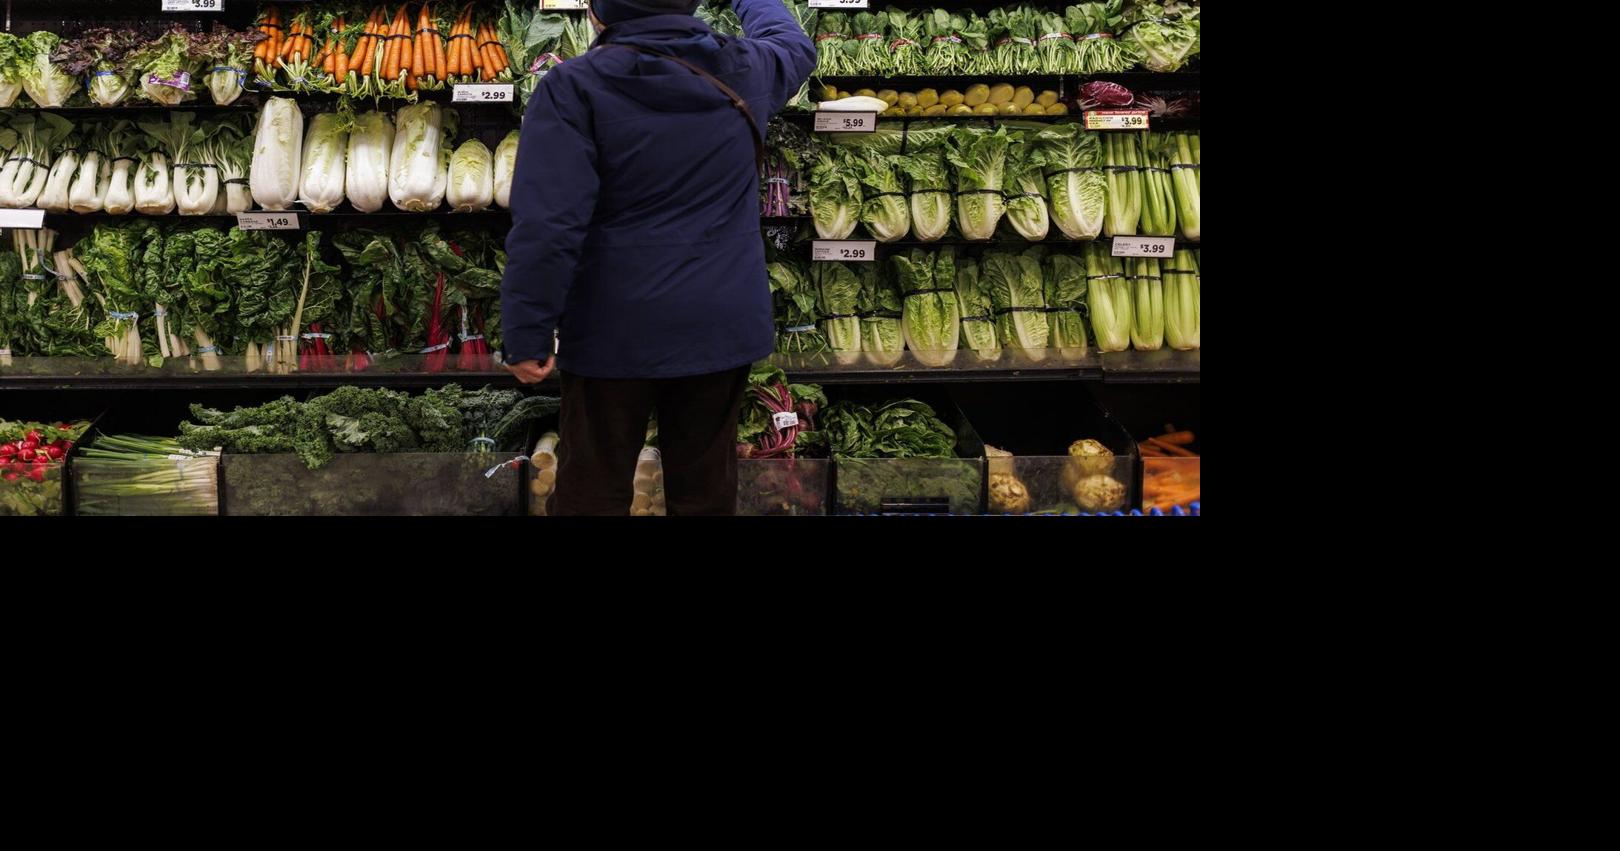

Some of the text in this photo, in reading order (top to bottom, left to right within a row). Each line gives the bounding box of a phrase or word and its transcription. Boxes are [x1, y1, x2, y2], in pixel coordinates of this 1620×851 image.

[481, 91, 506, 100] $2.99
[843, 118, 864, 127] $5.99
[1122, 116, 1142, 125] $3.99
[266, 218, 289, 226] $1.49
[840, 248, 866, 258] $2.99
[1140, 244, 1165, 253] $3.99
